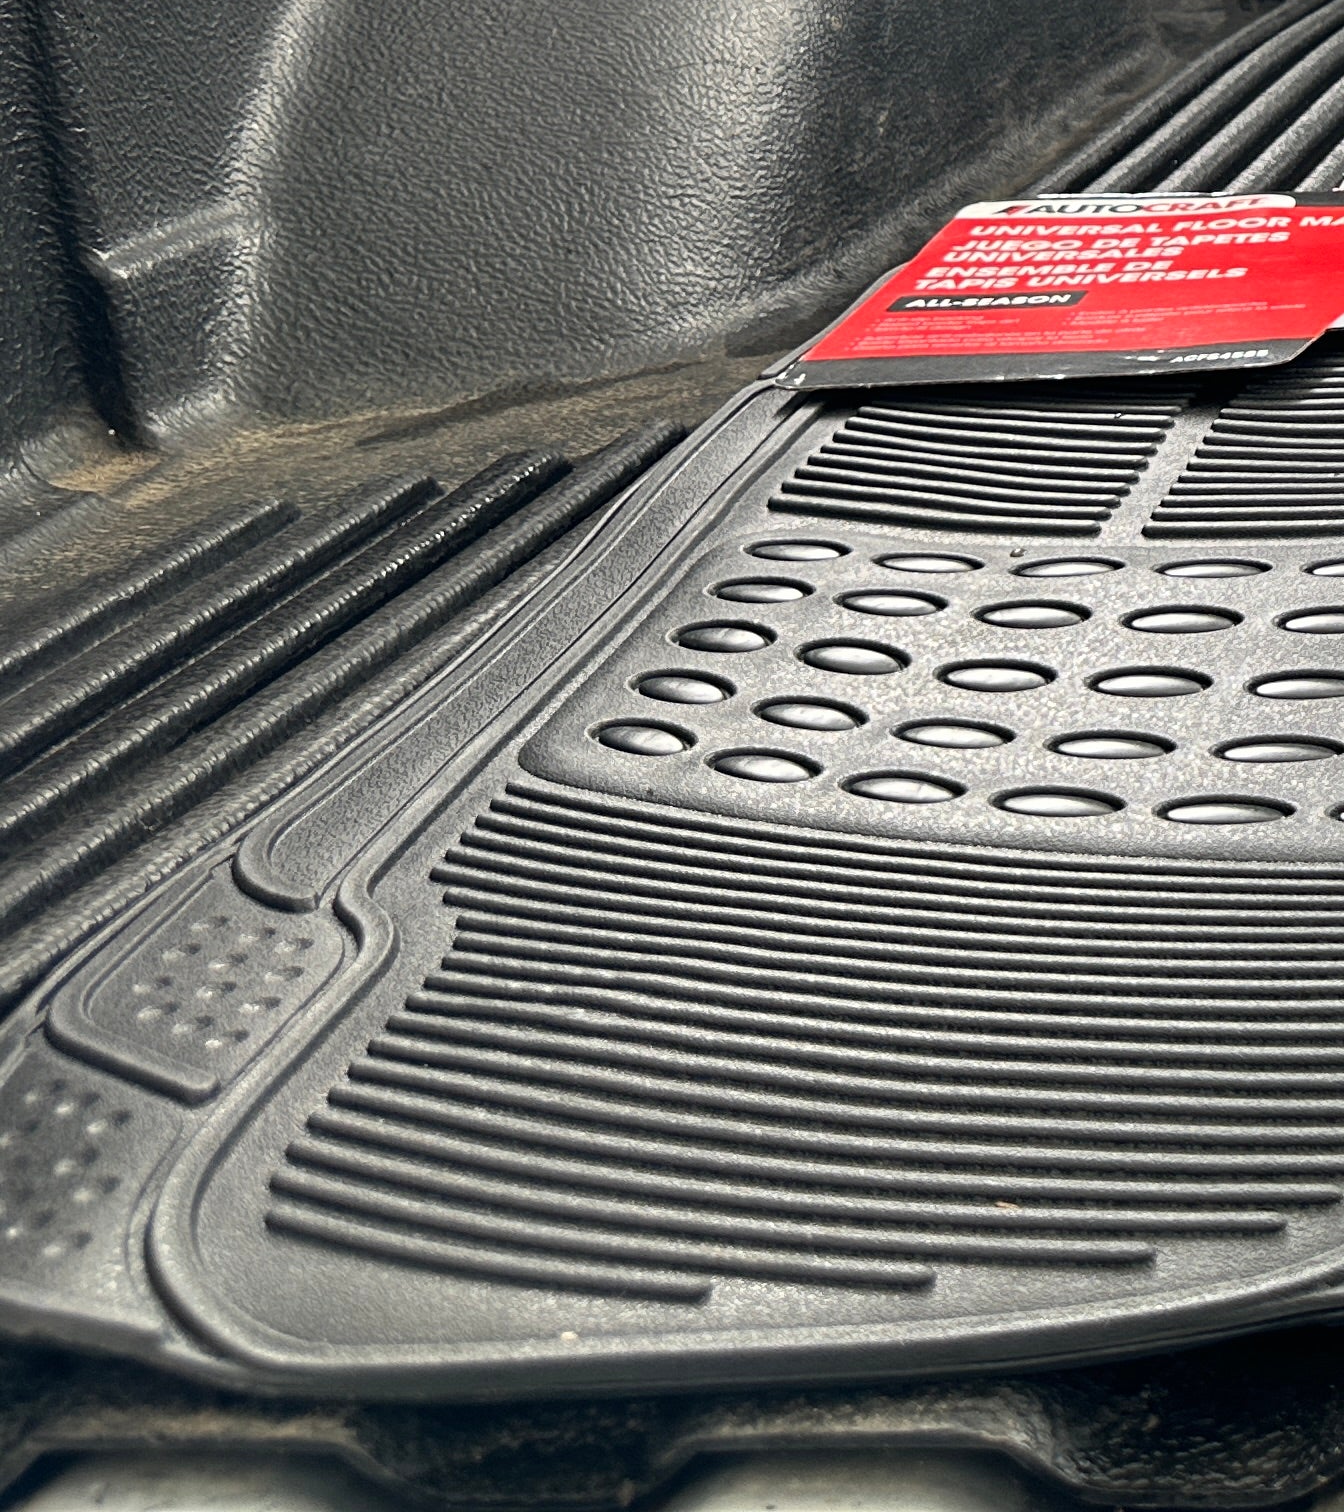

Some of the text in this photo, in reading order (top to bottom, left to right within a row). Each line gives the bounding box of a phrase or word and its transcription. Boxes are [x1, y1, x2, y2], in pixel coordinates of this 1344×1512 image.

[1027, 198, 1268, 214] AUTOCRAFT
[970, 223, 1162, 236] UNIVERSAL
[1172, 217, 1291, 232] FLOOR
[952, 232, 1290, 251] JUEGO DE TAPETES
[943, 247, 1184, 262] UNIVERSALES
[925, 260, 1173, 277] ENSEMBLE DE
[915, 267, 1248, 290] TAPIS UNIVERSELS
[905, 294, 1071, 308] ALL-SEASON
